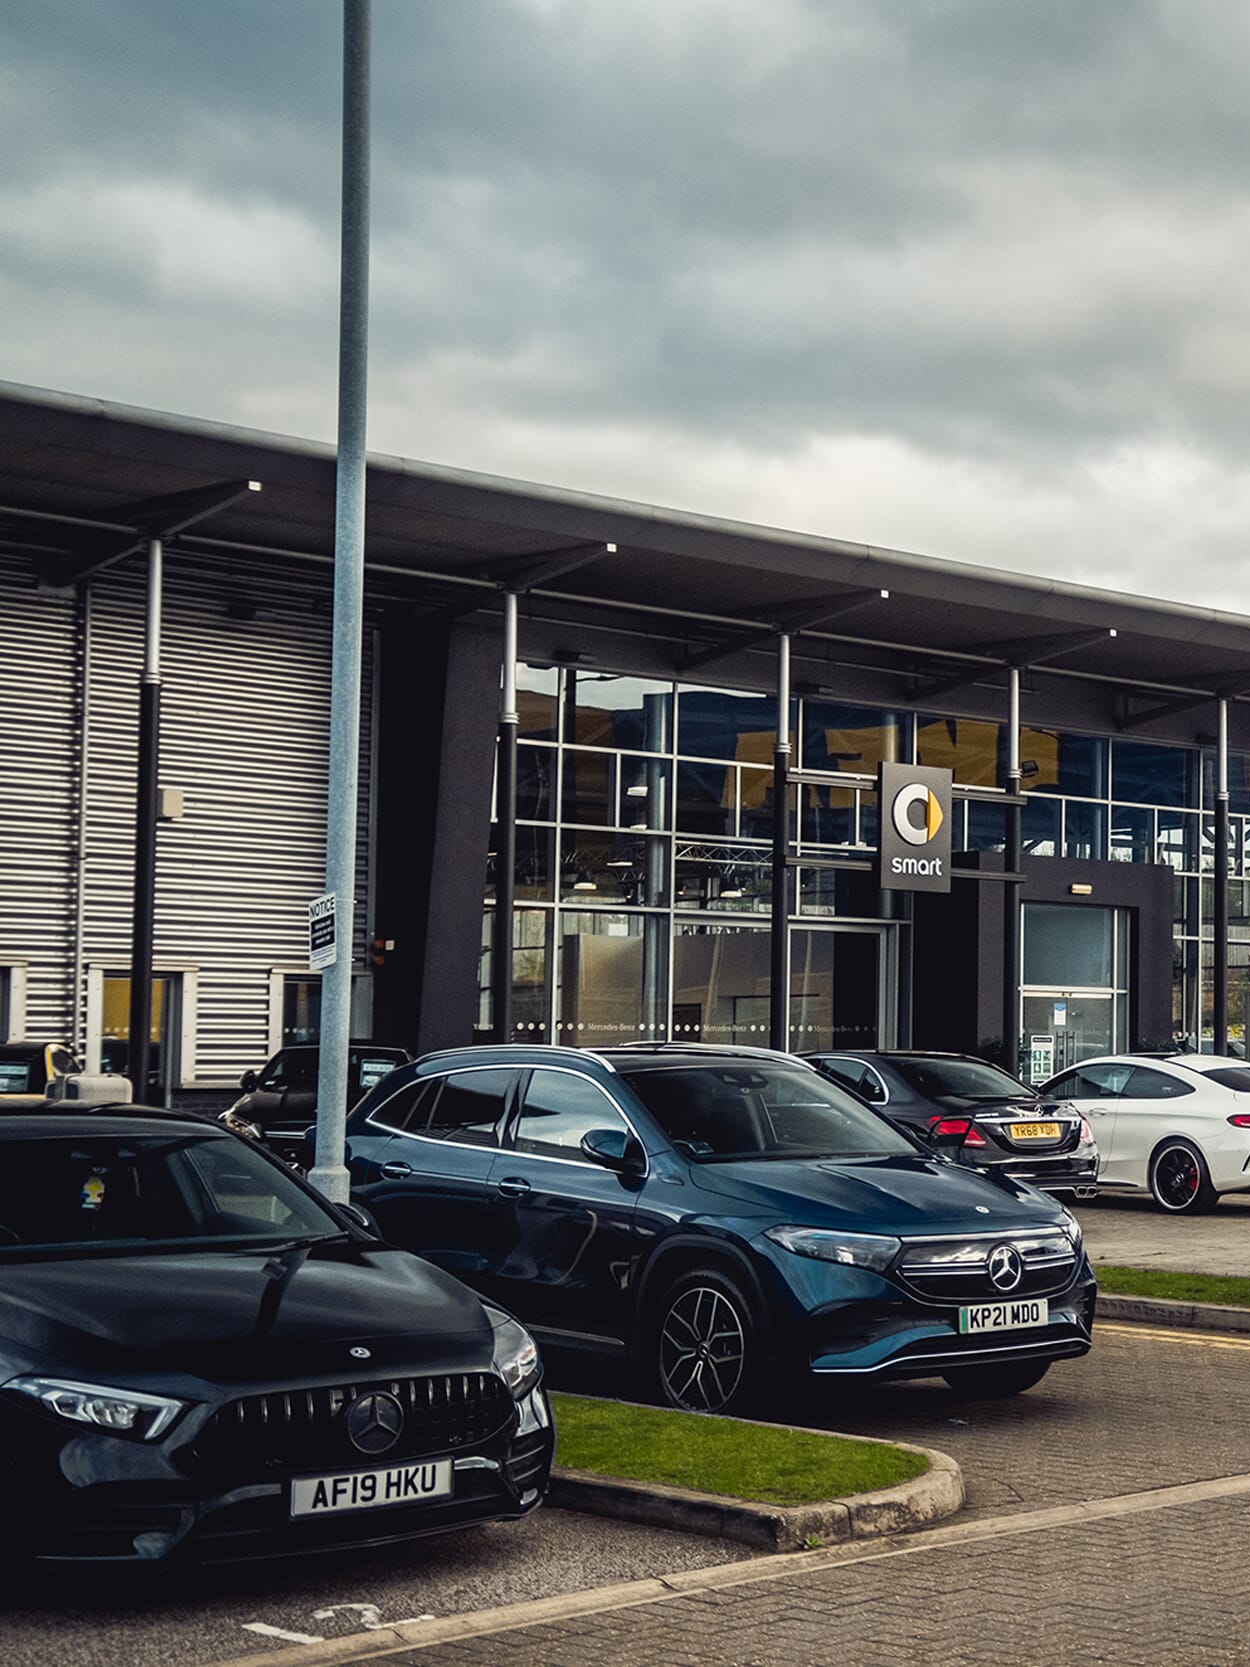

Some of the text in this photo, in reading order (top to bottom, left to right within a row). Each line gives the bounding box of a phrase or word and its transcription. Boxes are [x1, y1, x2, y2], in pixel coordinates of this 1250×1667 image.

[891, 857, 942, 876] smart
[310, 896, 335, 918] NOTICE
[587, 1023, 636, 1032] Mercedes-Benz
[970, 1303, 1040, 1329] KP21 MDO
[312, 1464, 436, 1509] AF19 HKU
